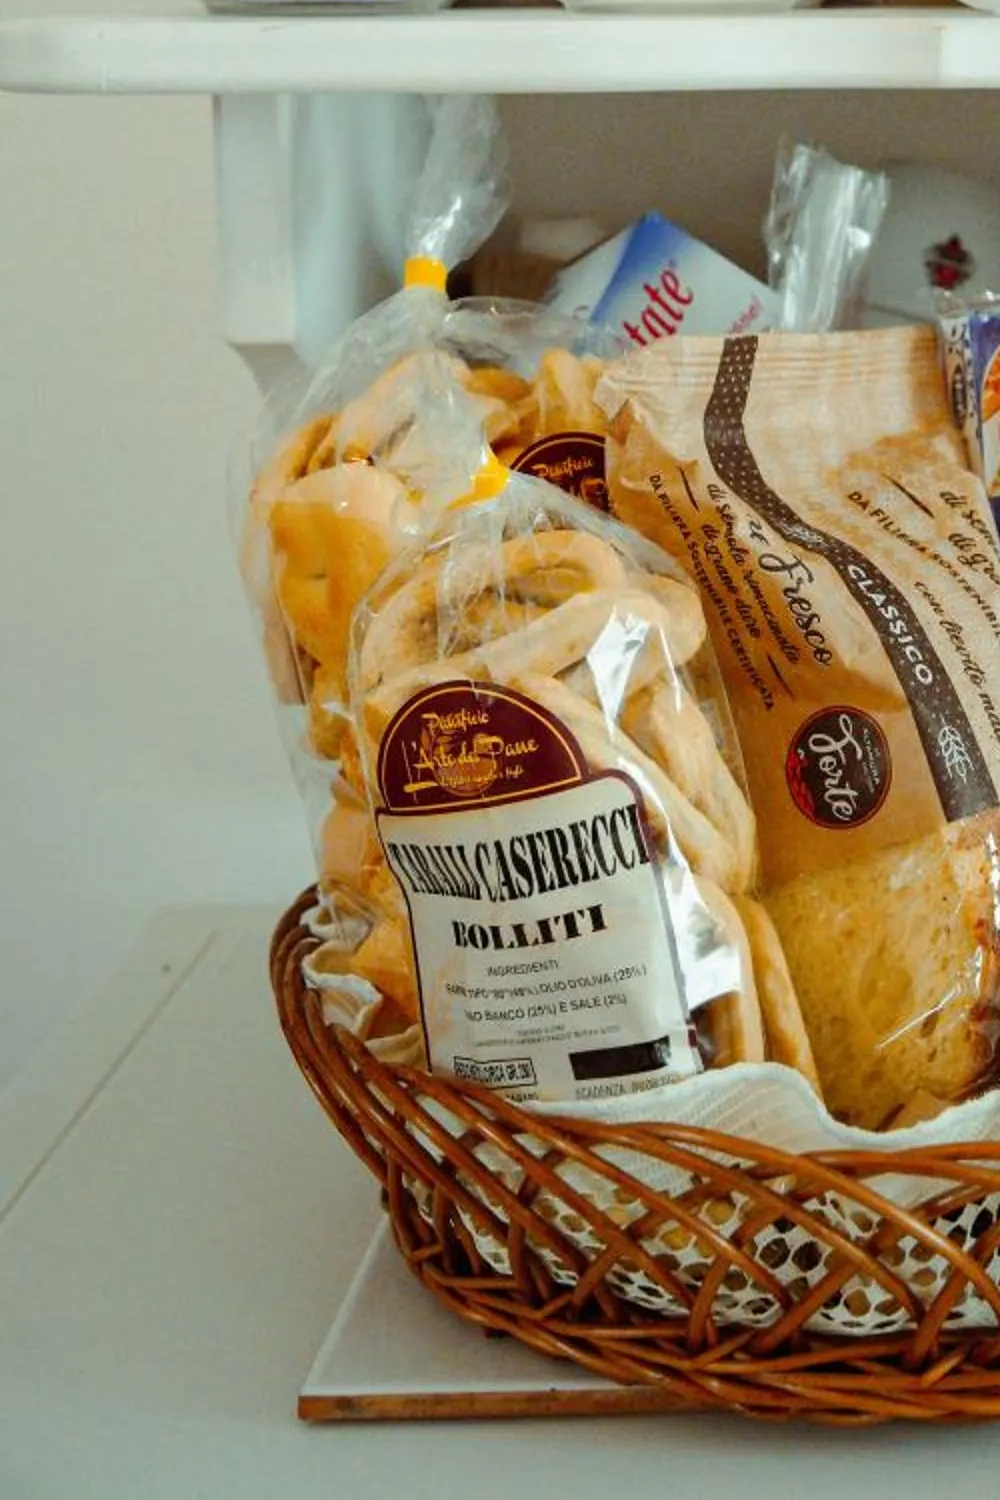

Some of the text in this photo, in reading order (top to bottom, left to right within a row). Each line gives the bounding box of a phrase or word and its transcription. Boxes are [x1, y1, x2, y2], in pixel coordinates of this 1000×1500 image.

[847, 490, 871, 511] DA
[758, 553, 833, 667] Fresco
[846, 562, 934, 685] CLASSICO
[809, 714, 862, 821] Forte
[474, 804, 650, 903] CASERECCI
[452, 904, 608, 950] BOLLITI
